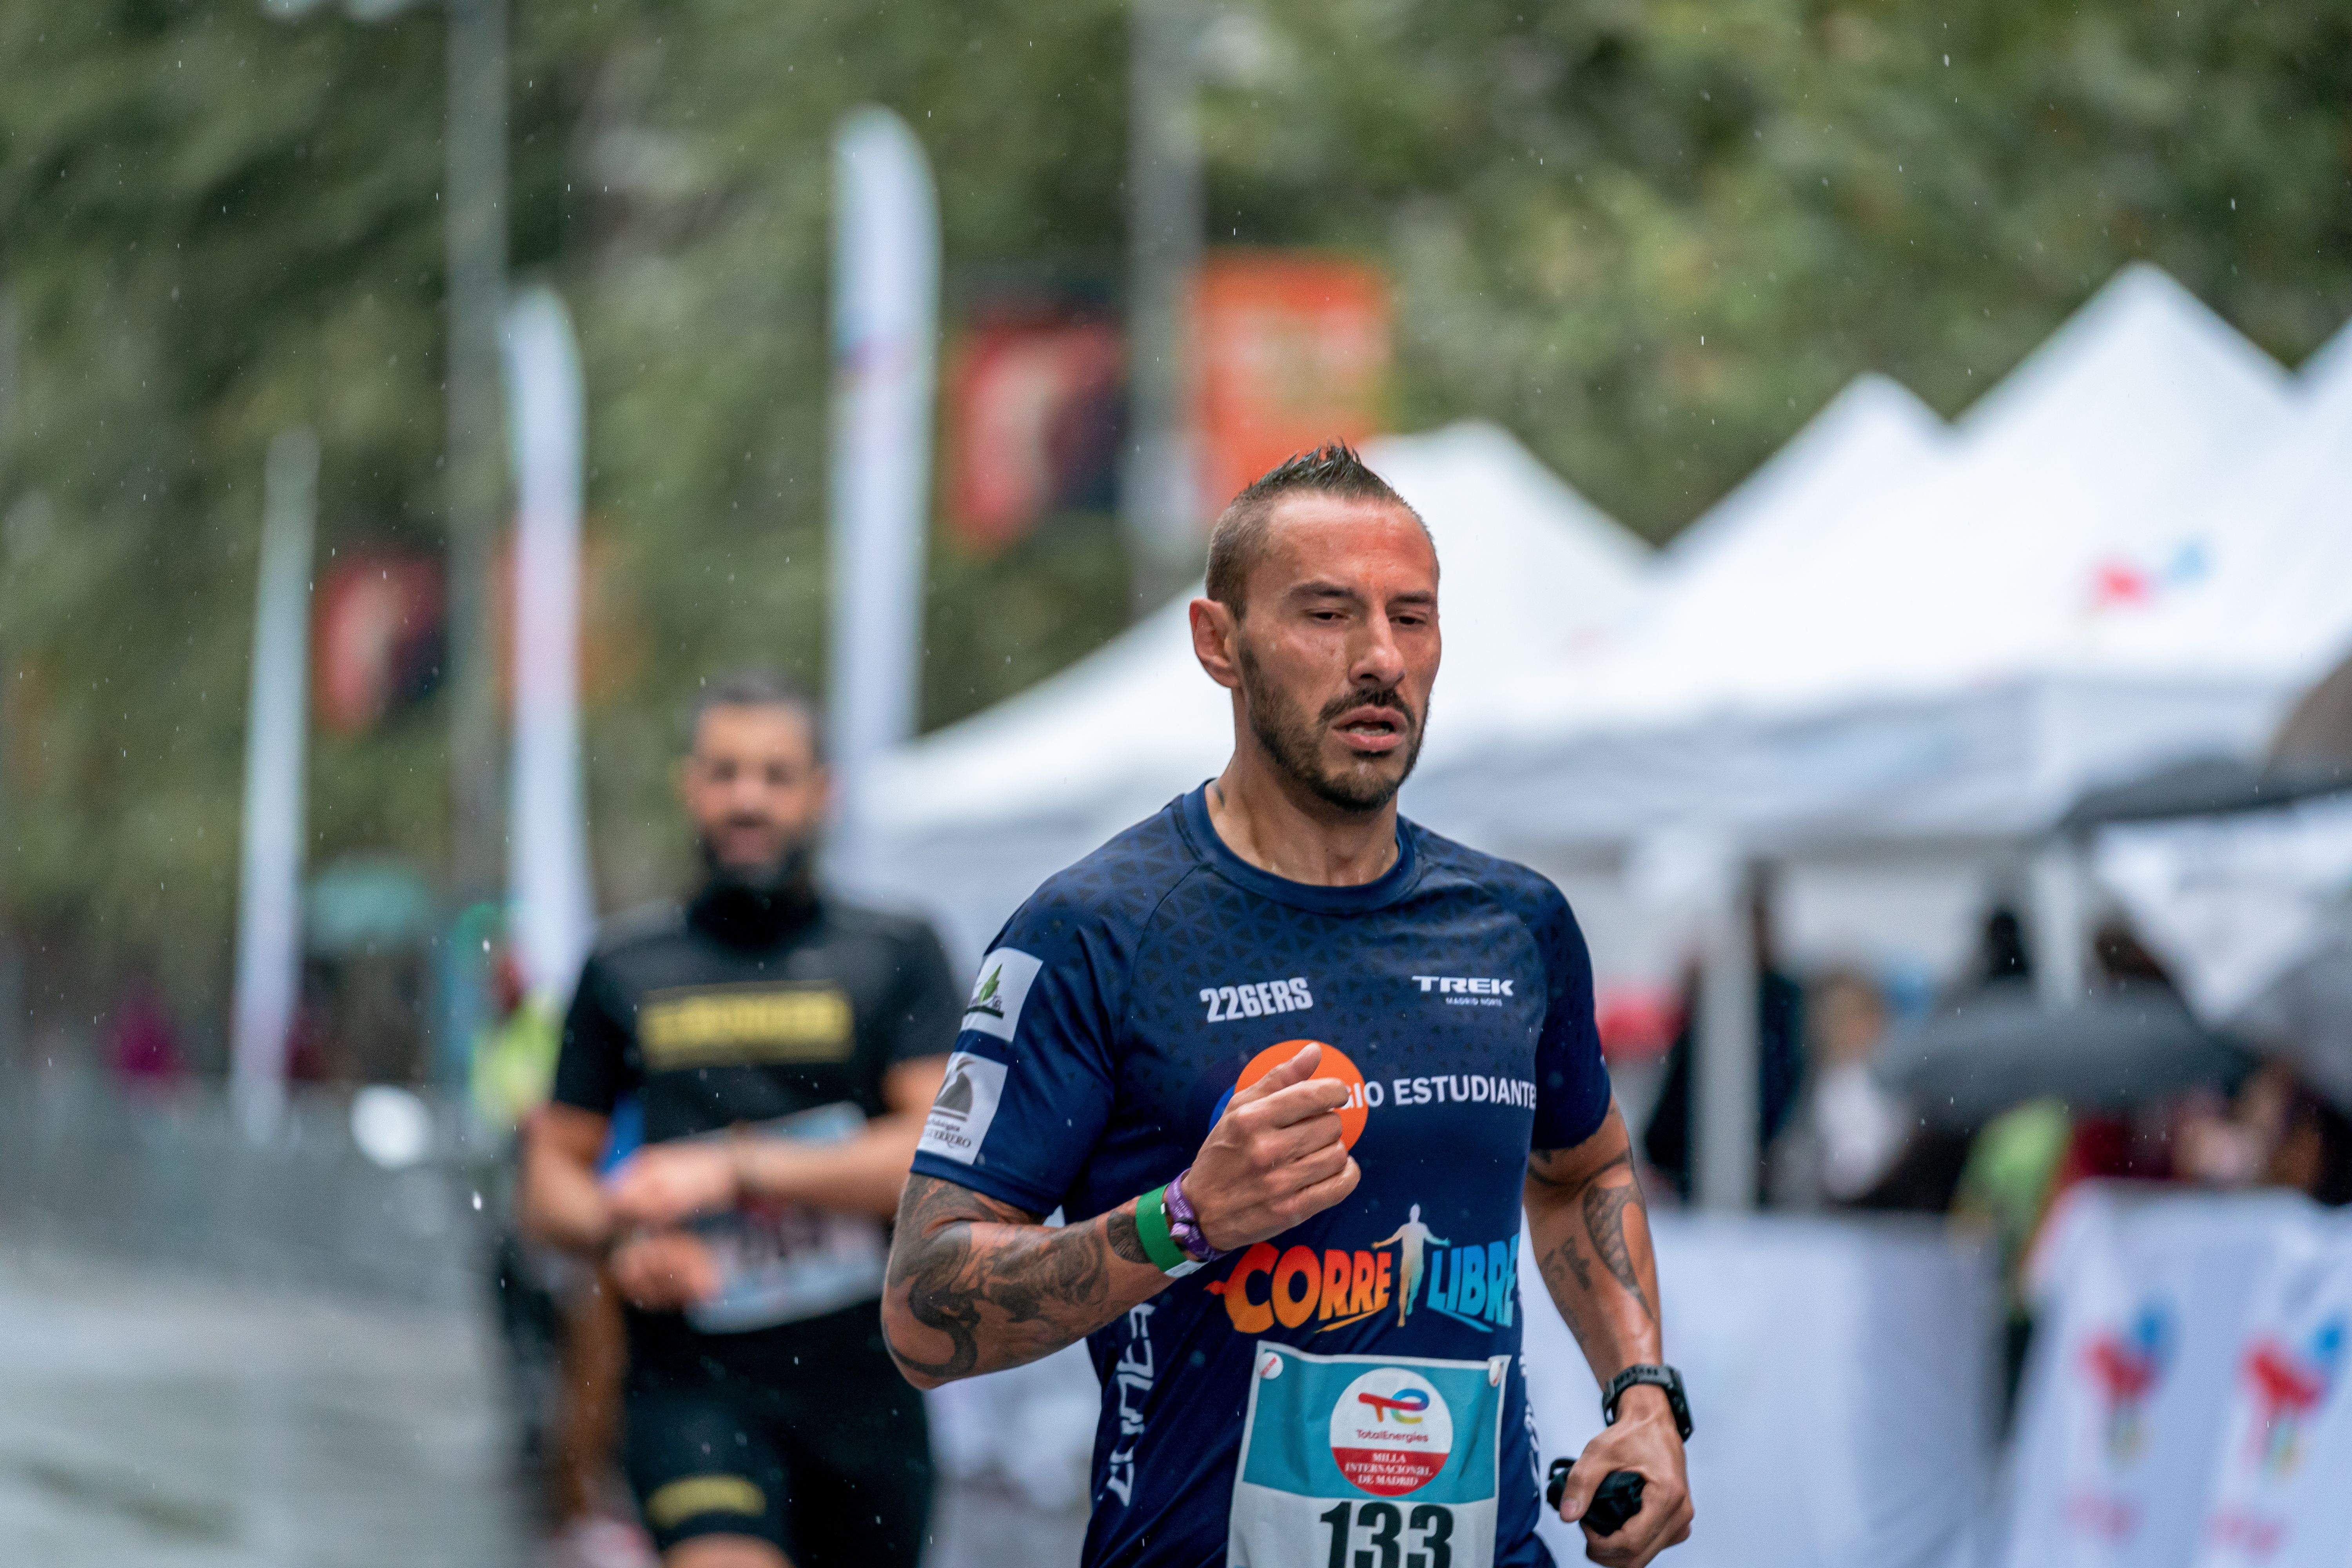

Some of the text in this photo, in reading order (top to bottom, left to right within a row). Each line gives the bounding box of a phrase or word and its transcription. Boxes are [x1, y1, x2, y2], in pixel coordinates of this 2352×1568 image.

[1412, 975, 1514, 996] TREK
[1200, 977, 1313, 1023] 226ERS
[1204, 1240, 1392, 1334] CORRE
[1356, 1429, 1429, 1444] TotalEnergies
[1372, 1452, 1406, 1463] MILLA
[1345, 1462, 1433, 1476] INTERNACIONAL
[1357, 1474, 1419, 1487] DE MADRID
[1320, 1501, 1454, 1568] 133
